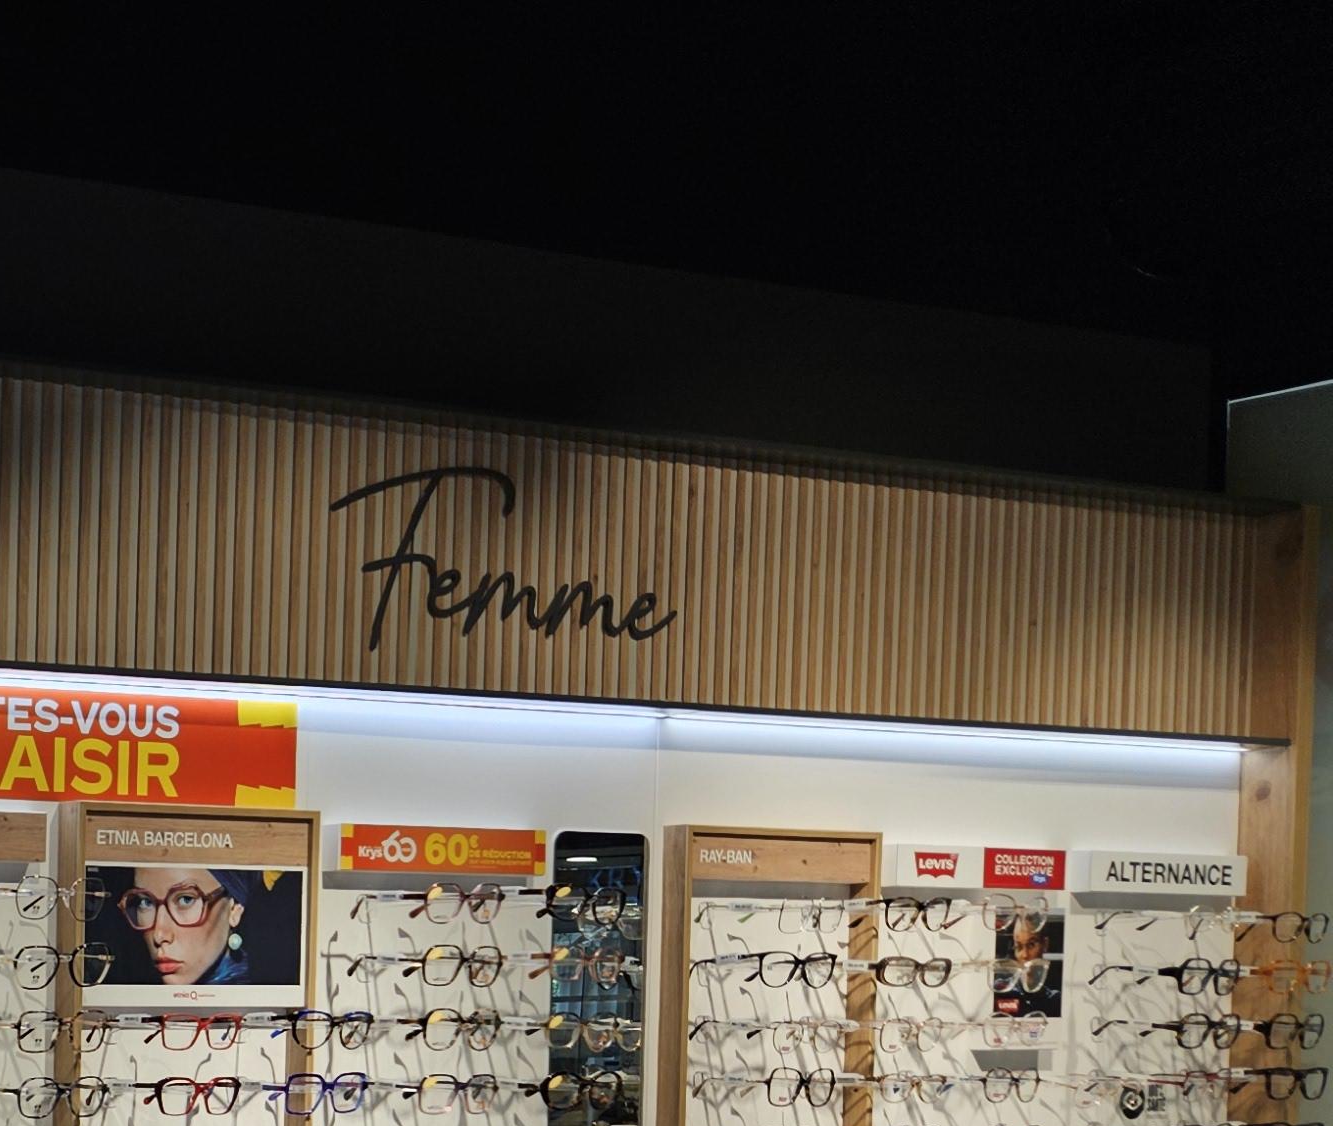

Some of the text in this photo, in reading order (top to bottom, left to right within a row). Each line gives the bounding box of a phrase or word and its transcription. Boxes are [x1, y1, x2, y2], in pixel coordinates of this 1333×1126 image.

[329, 466, 677, 652] Femme
[96, 829, 233, 849] ETNIA BARCELONA
[358, 845, 383, 860] Krys
[699, 848, 752, 866] RAY-BAN
[995, 854, 1055, 866] COLLECTION
[994, 864, 1054, 877] EXCLUSIVE
[1106, 861, 1233, 886] ALTERNANCE
